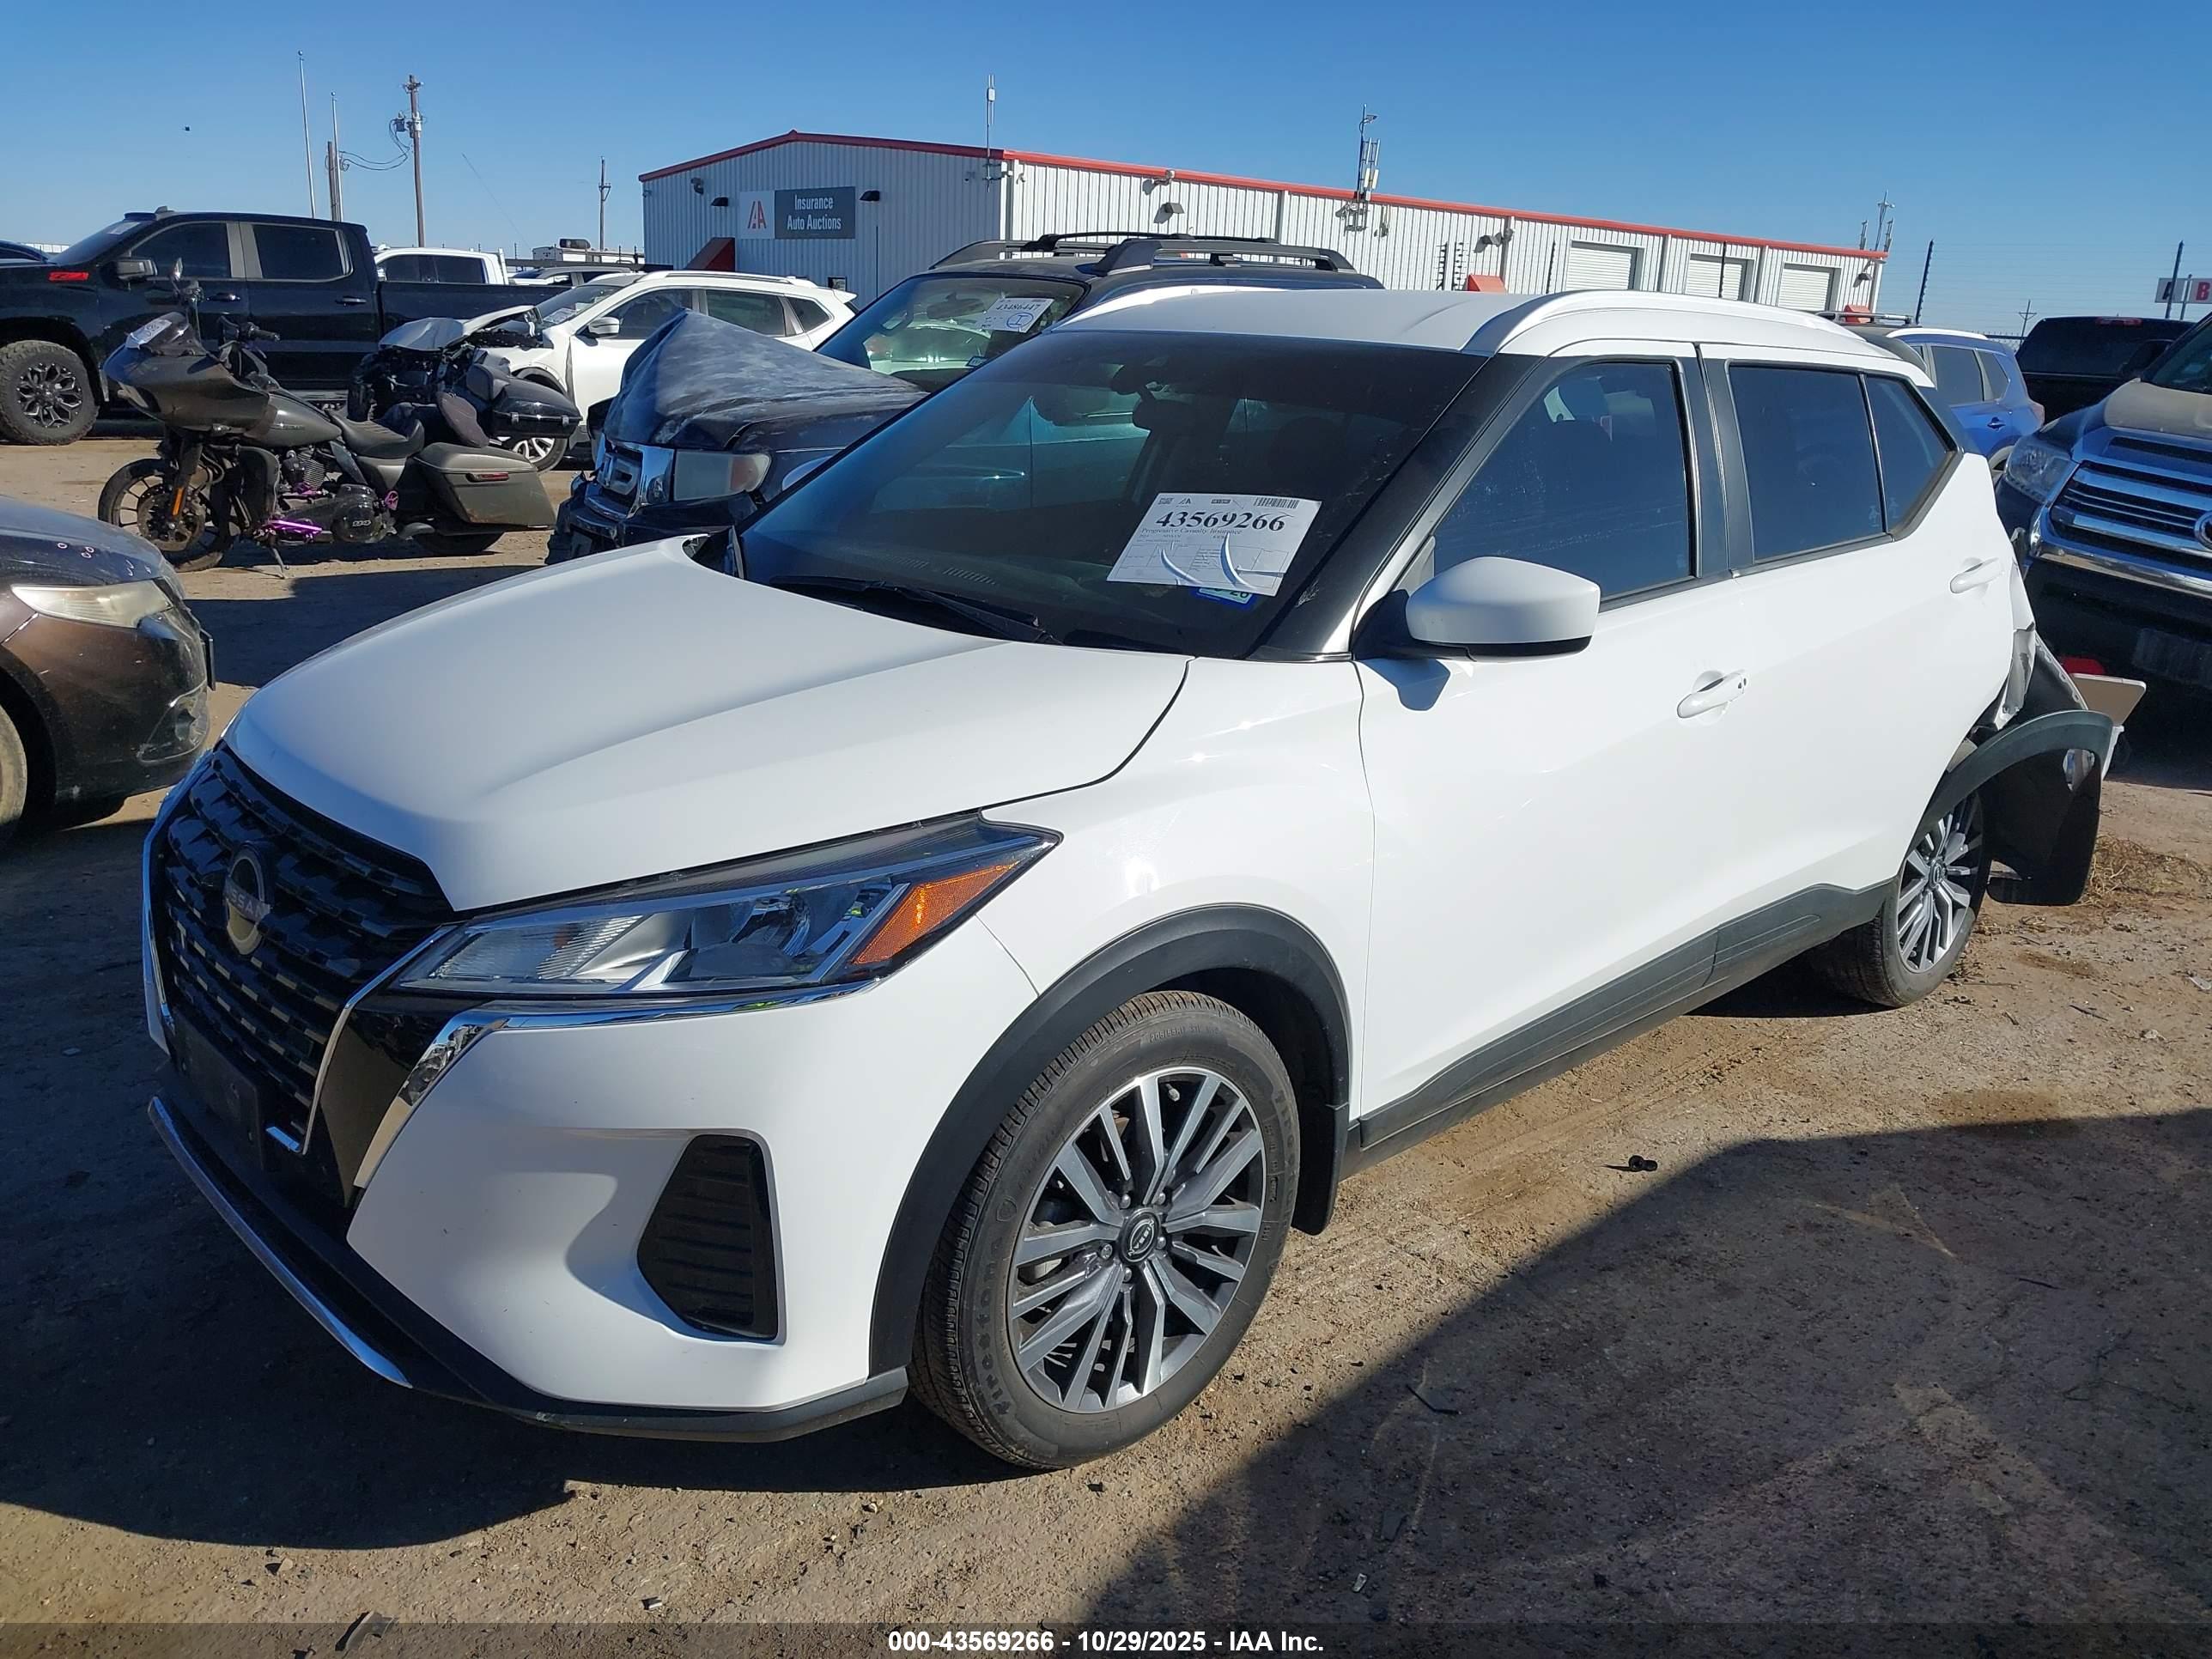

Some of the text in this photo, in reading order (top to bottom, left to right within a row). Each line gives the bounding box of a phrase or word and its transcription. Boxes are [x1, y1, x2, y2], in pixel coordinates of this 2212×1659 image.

[794, 194, 834, 210] Insurance
[787, 213, 842, 230] Auto Auctions
[1155, 511, 1291, 532] 43569266
